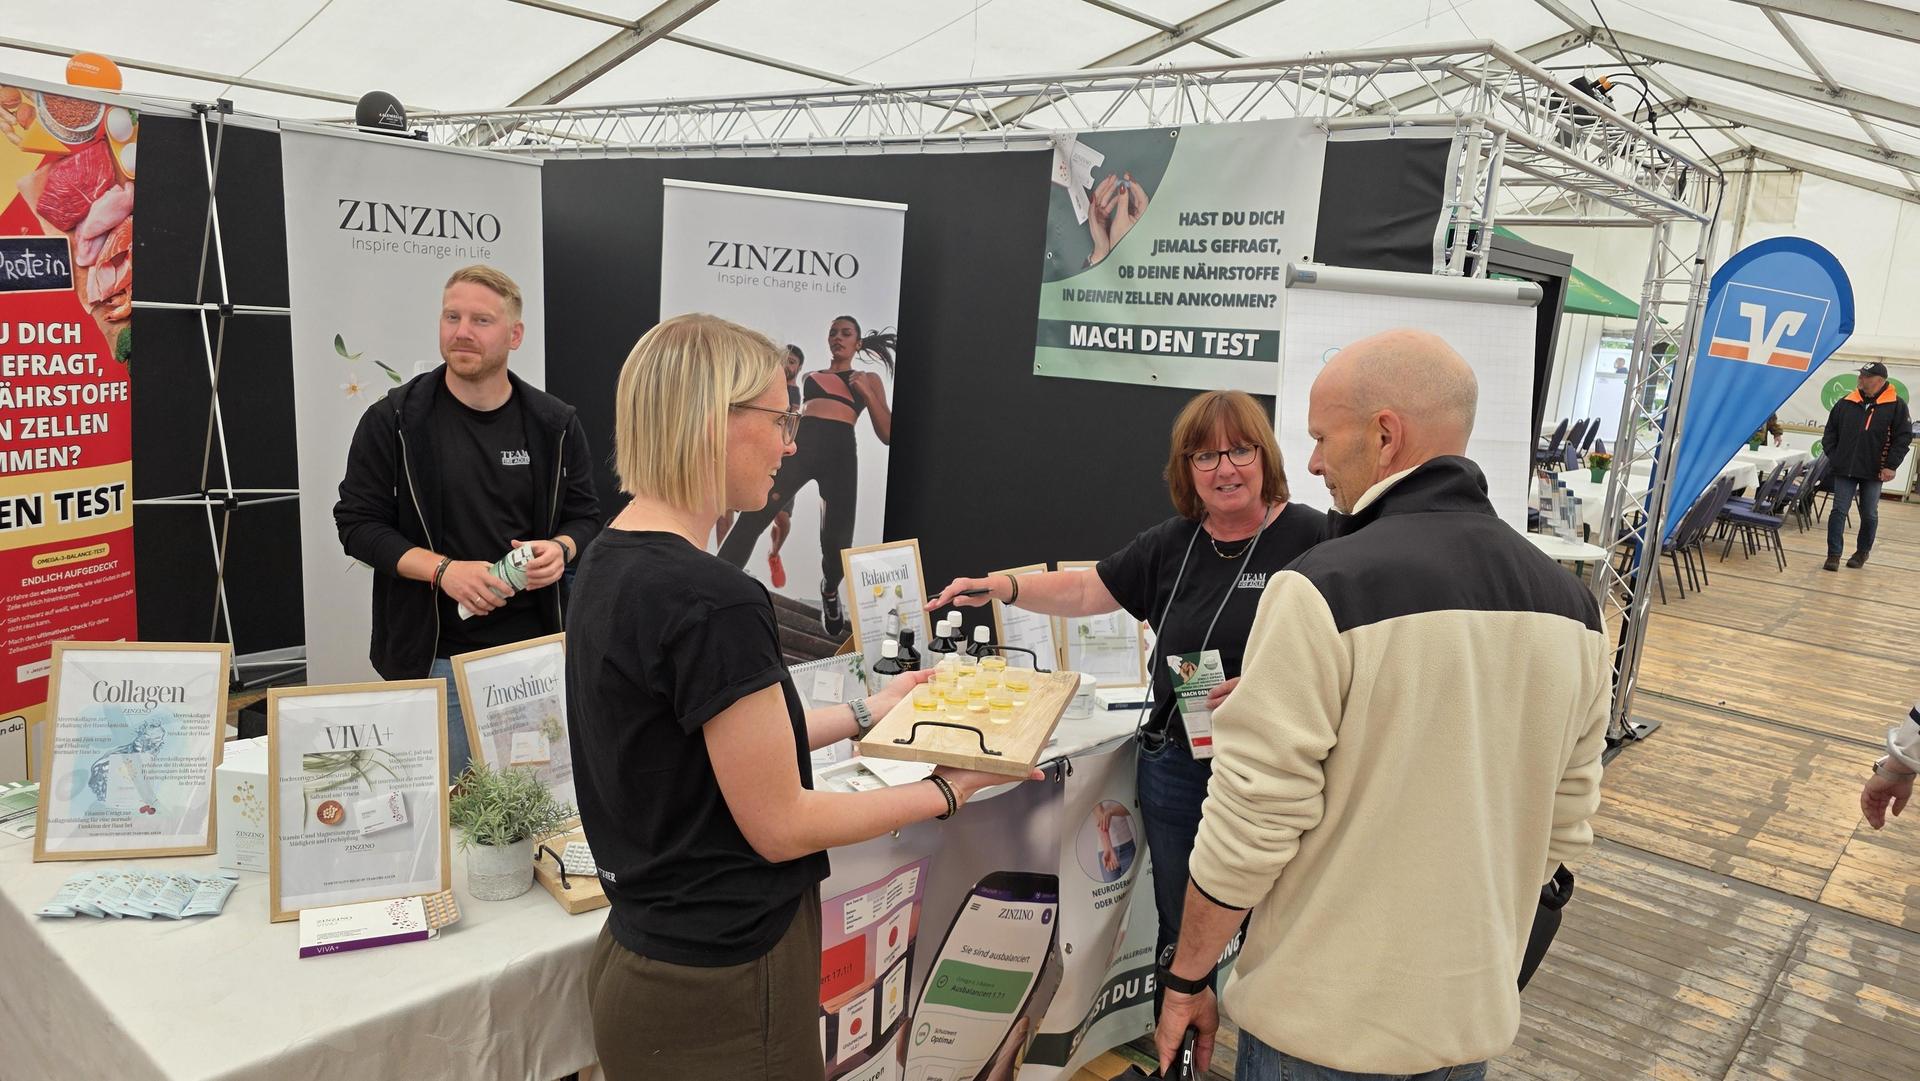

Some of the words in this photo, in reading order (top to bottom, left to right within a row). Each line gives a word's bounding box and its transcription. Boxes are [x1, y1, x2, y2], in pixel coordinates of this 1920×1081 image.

[339, 198, 501, 243] ZINZINO
[1179, 212, 1219, 226] HAST
[1222, 212, 1246, 226] DU
[1249, 211, 1285, 226] DICH
[352, 236, 399, 254] Inspire
[403, 239, 451, 260] Change
[455, 244, 467, 257] in
[471, 246, 491, 260] Life
[1151, 239, 1207, 256] JEMALS
[1211, 238, 1281, 256] GEFRAGT,
[707, 240, 859, 281] ZINZINO
[1118, 265, 1135, 279] OB
[1137, 265, 1180, 280] DEINE
[1183, 263, 1279, 281] NÄHRSTOFFE
[718, 271, 759, 287] Inspire
[763, 275, 808, 293] Change
[813, 279, 823, 291] in
[826, 281, 848, 295] Life
[1063, 288, 1075, 302] IN
[1077, 289, 1123, 304] DEINEN
[1125, 291, 1174, 306] ZELLEN
[1177, 292, 1277, 308] ANKOMMEN?
[18, 321, 81, 344] DICH
[1070, 324, 1134, 350] MACH
[1141, 329, 1194, 354] DEN
[1201, 331, 1260, 357] TEST
[2, 353, 104, 378] EFRAGT,
[20, 412, 109, 440] ZELLEN
[500, 449, 529, 459] TEAM
[54, 483, 125, 521] TEST
[21, 570, 64, 587] ENDLICH
[64, 560, 119, 579] AUFGEDECKT
[93, 679, 185, 709] Collagen
[8, 723, 25, 734] du:
[325, 723, 395, 751] VIVA+
[345, 843, 375, 852] ZINZINO
[998, 908, 1034, 921] ZINZINO
[1094, 898, 1113, 910] ODER
[317, 946, 339, 954] VIVA+
[961, 944, 973, 955] Sie
[973, 949, 991, 958] sind
[1112, 977, 1140, 1004] DU
[930, 1034, 955, 1046] Optimal
